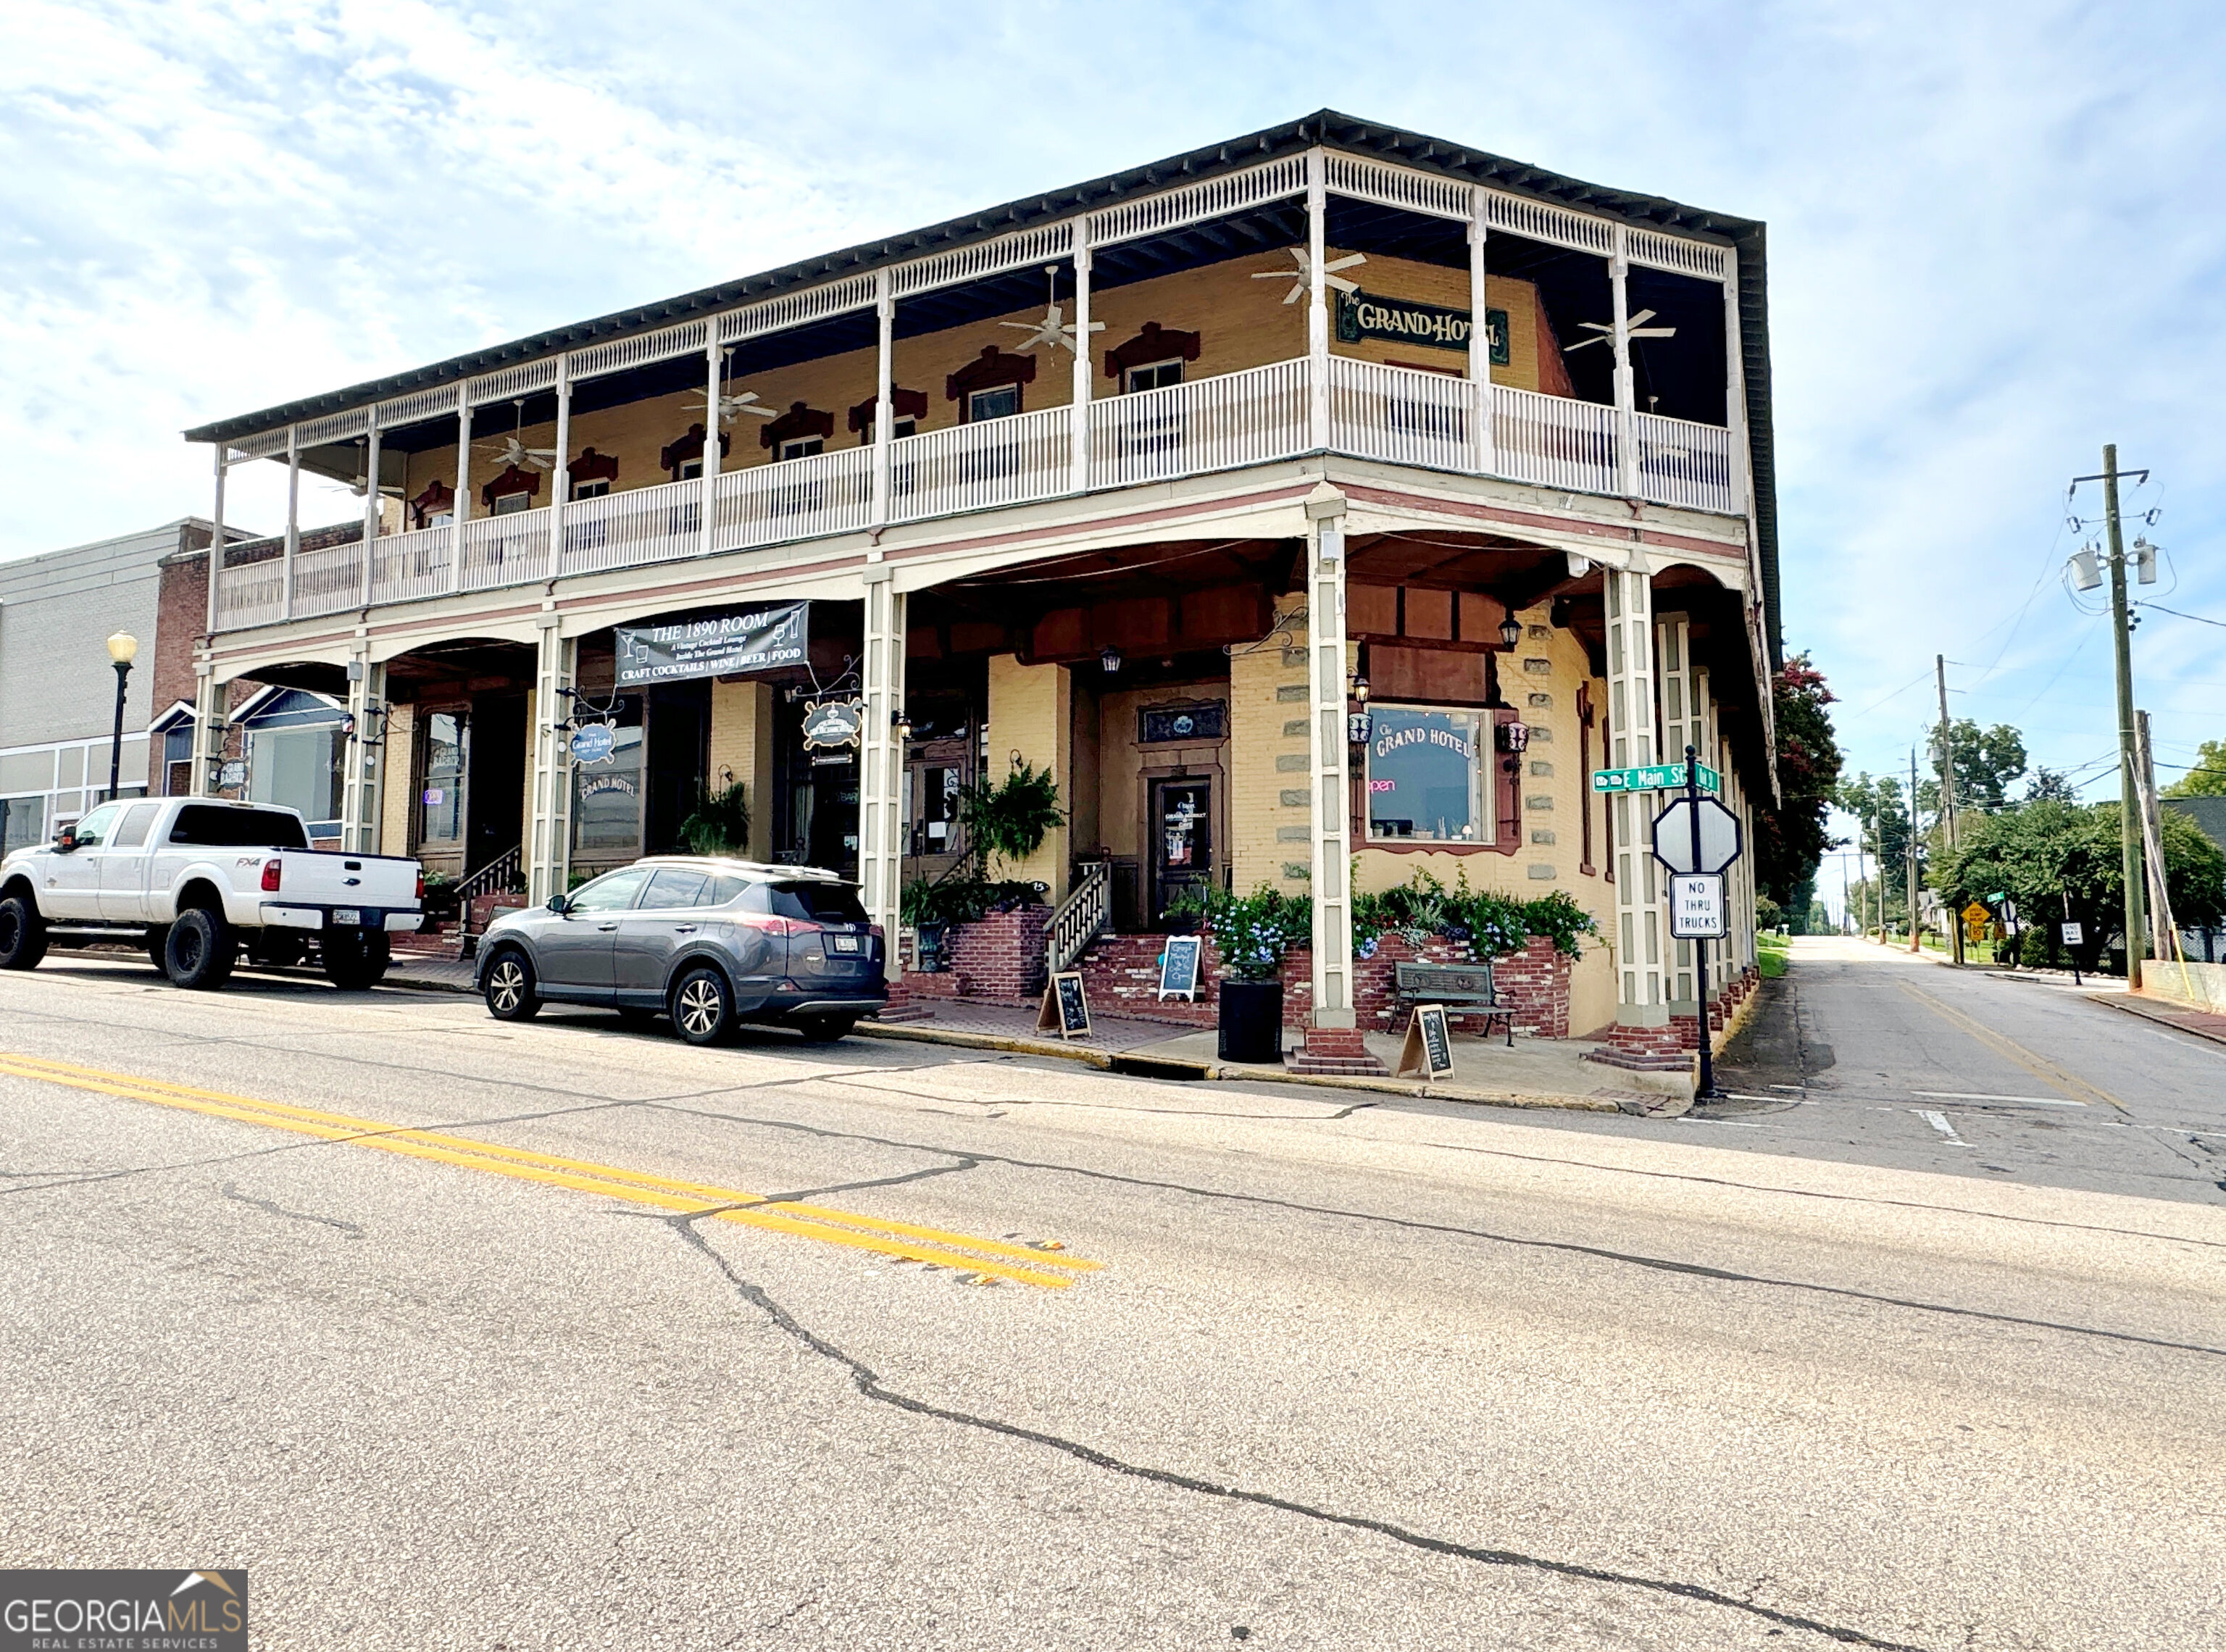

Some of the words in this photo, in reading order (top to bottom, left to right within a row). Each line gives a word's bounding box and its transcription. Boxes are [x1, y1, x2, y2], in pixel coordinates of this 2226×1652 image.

[1357, 303, 1433, 335] GRAND
[1433, 312, 1500, 347] HOTL
[652, 625, 682, 643] THE
[685, 620, 717, 638] 1890
[720, 612, 770, 633] ROOM
[699, 637, 723, 648] Cocktail
[724, 635, 747, 645] Lounge
[694, 649, 705, 659] The
[706, 647, 725, 656] Grand
[726, 644, 743, 654] Hotel
[622, 667, 651, 680] CRAFT
[652, 661, 704, 677] COCKTAILS
[710, 656, 735, 669] WINE
[740, 652, 766, 665] BEER
[771, 648, 801, 661] FOOD
[1377, 727, 1425, 757] GRAND
[1430, 728, 1470, 759] HOTEL
[1624, 771, 1631, 788] E
[1638, 768, 1664, 786] Main
[1670, 767, 1685, 784] St
[582, 777, 609, 801] GRAND
[610, 777, 635, 798] HOTEL
[1369, 780, 1395, 795] pen
[235, 857, 261, 869] FX4
[1688, 883, 1705, 893] NO
[1685, 900, 1710, 911] THRU
[1680, 917, 1717, 929] TRUCKS
